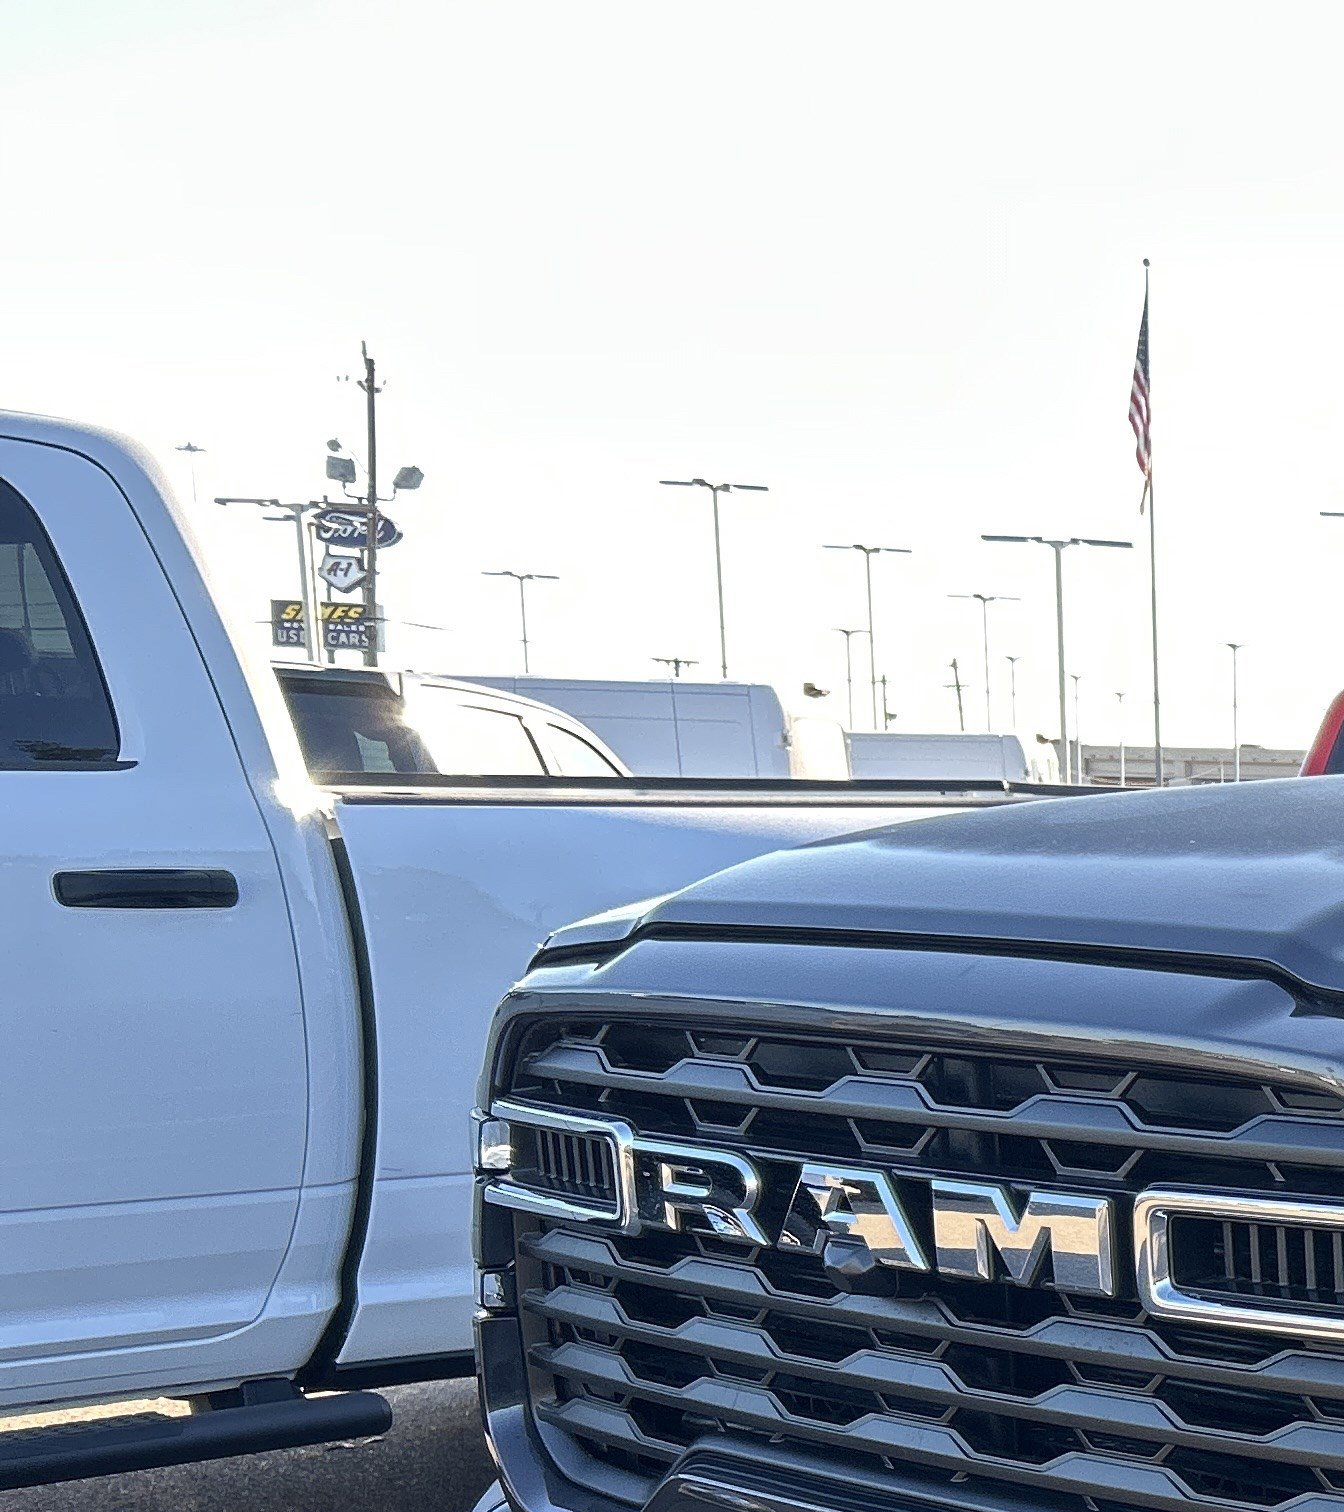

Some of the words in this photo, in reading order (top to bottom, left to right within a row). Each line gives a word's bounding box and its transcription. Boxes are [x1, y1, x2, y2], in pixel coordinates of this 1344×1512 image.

[327, 561, 353, 577] A-1
[327, 632, 369, 646] CARS
[634, 1137, 1114, 1298] RAM
